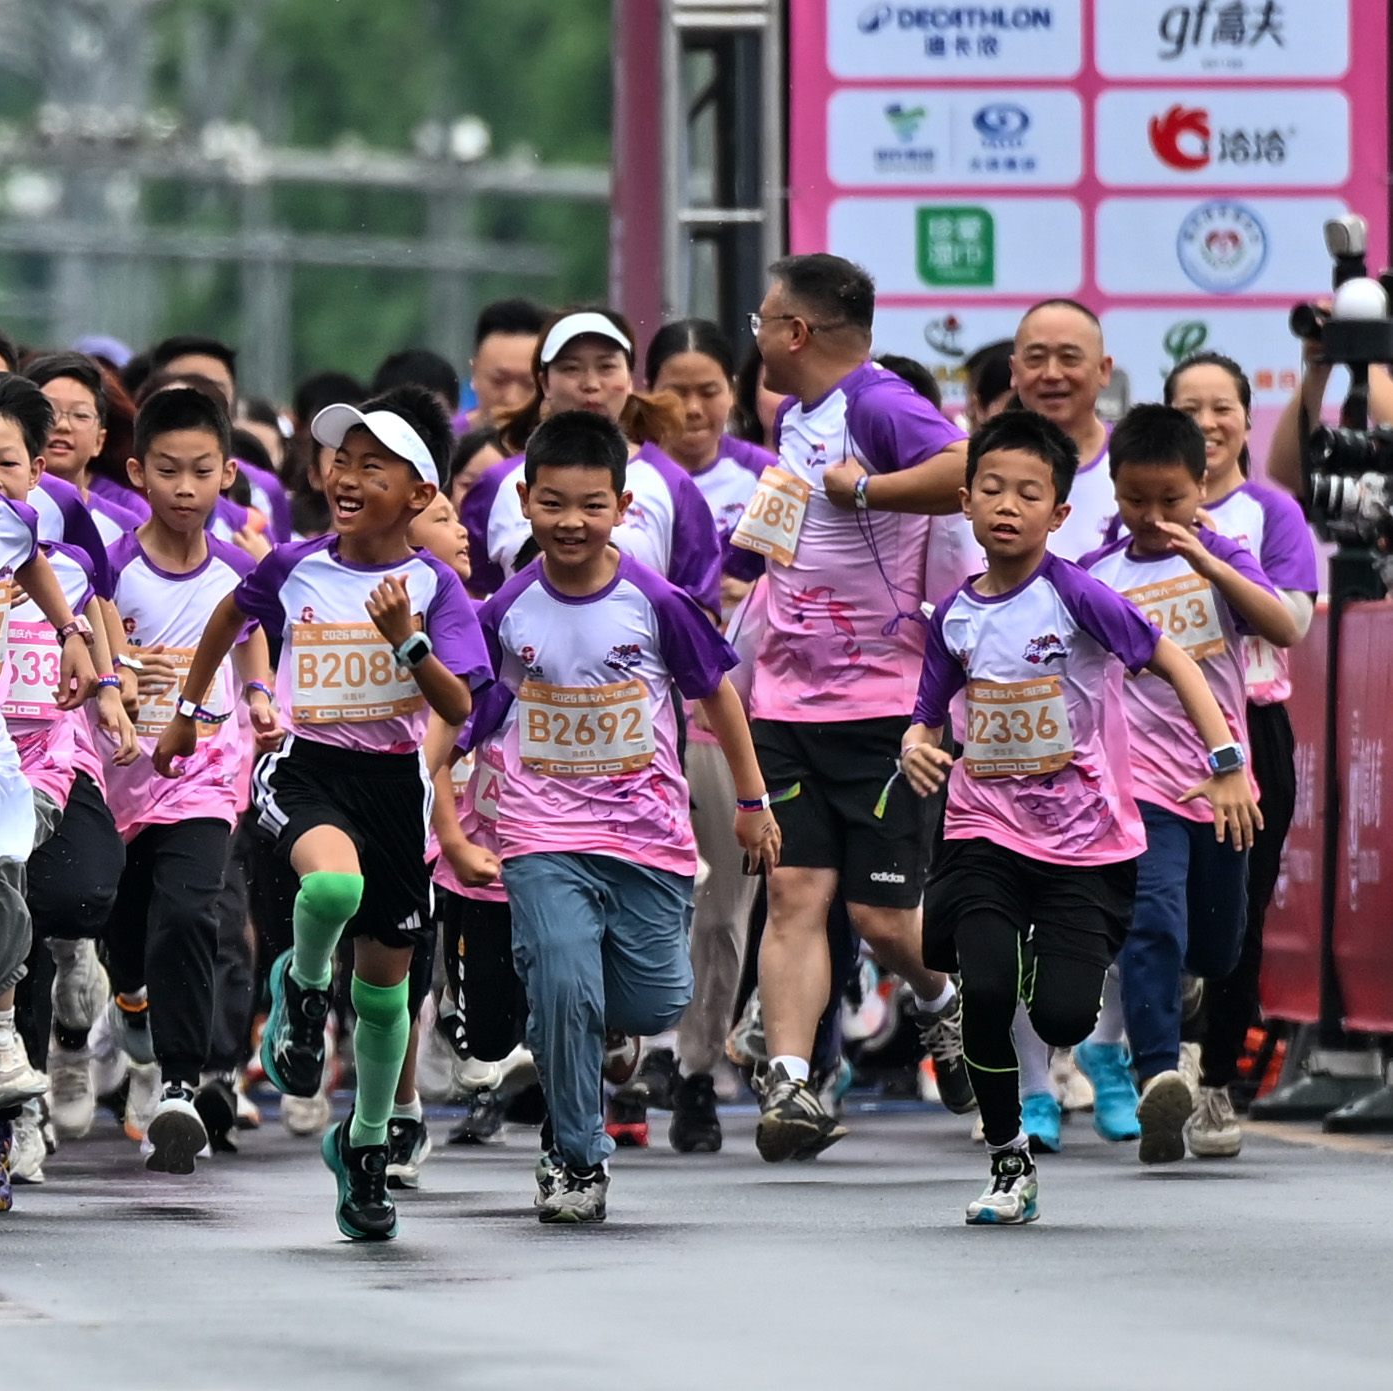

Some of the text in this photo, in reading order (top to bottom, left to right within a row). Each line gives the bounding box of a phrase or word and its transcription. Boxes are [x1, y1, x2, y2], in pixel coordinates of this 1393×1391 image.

[896, 9, 1053, 31] DECATHLON
[1218, 128, 1286, 165] 洽洽
[748, 491, 799, 535] 085
[1145, 598, 1209, 635] 963
[528, 707, 644, 747] B2692
[870, 871, 906, 884] adidas
